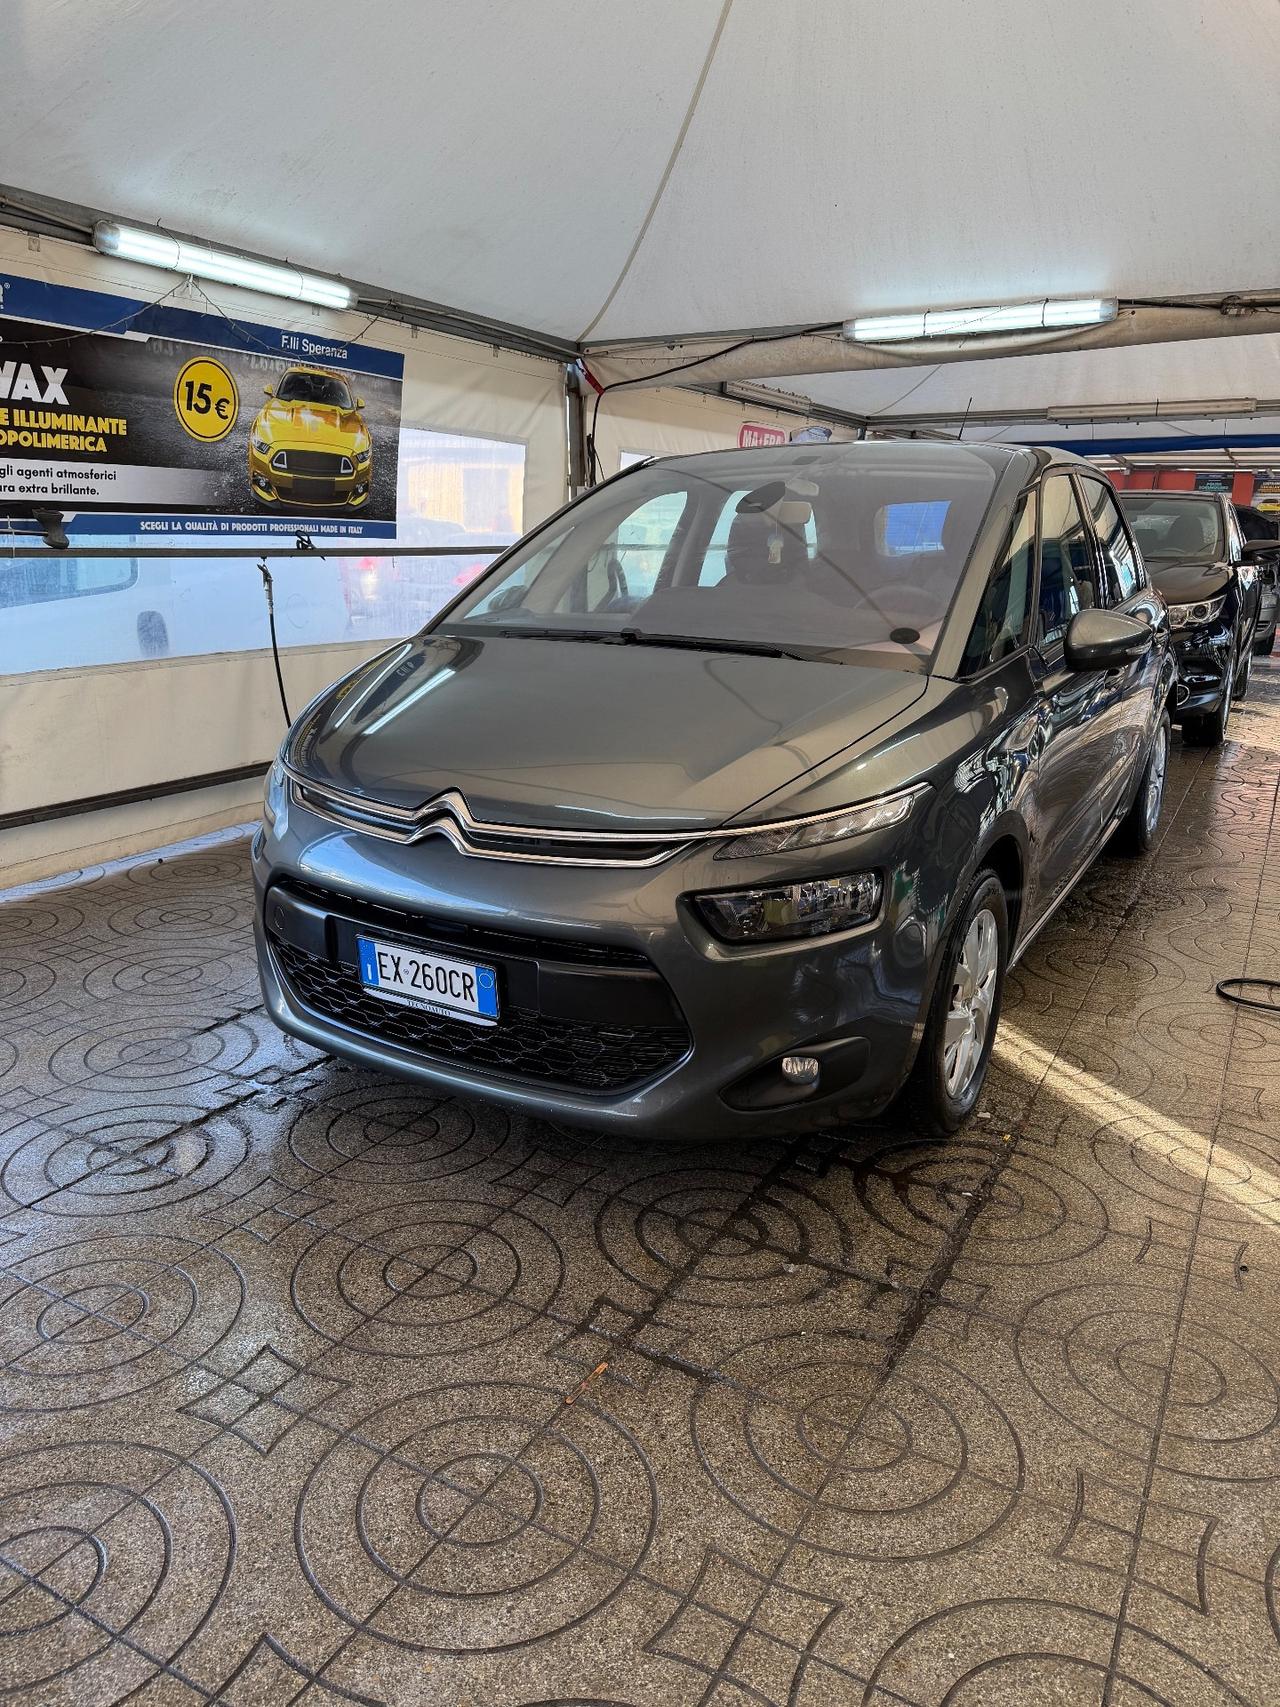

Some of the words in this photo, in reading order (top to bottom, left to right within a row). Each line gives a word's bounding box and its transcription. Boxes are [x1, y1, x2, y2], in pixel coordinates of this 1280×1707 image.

[301, 338, 348, 360] Speranza
[13, 408, 128, 436] ILLUMINANTE
[17, 467, 53, 479] agenti
[56, 468, 117, 481] atmosferici
[18, 483, 48, 494] extra
[51, 482, 100, 496] brillante.
[140, 521, 169, 531] SCEGLI
[171, 521, 182, 531] LA
[185, 520, 218, 531] QUALITÀ
[220, 522, 229, 531] DI
[231, 522, 267, 532] PRODOTTI
[269, 523, 319, 533] PROFESSIONALI
[320, 525, 338, 534] MADE
[339, 525, 346, 534] IN
[348, 526, 364, 534] ITALY
